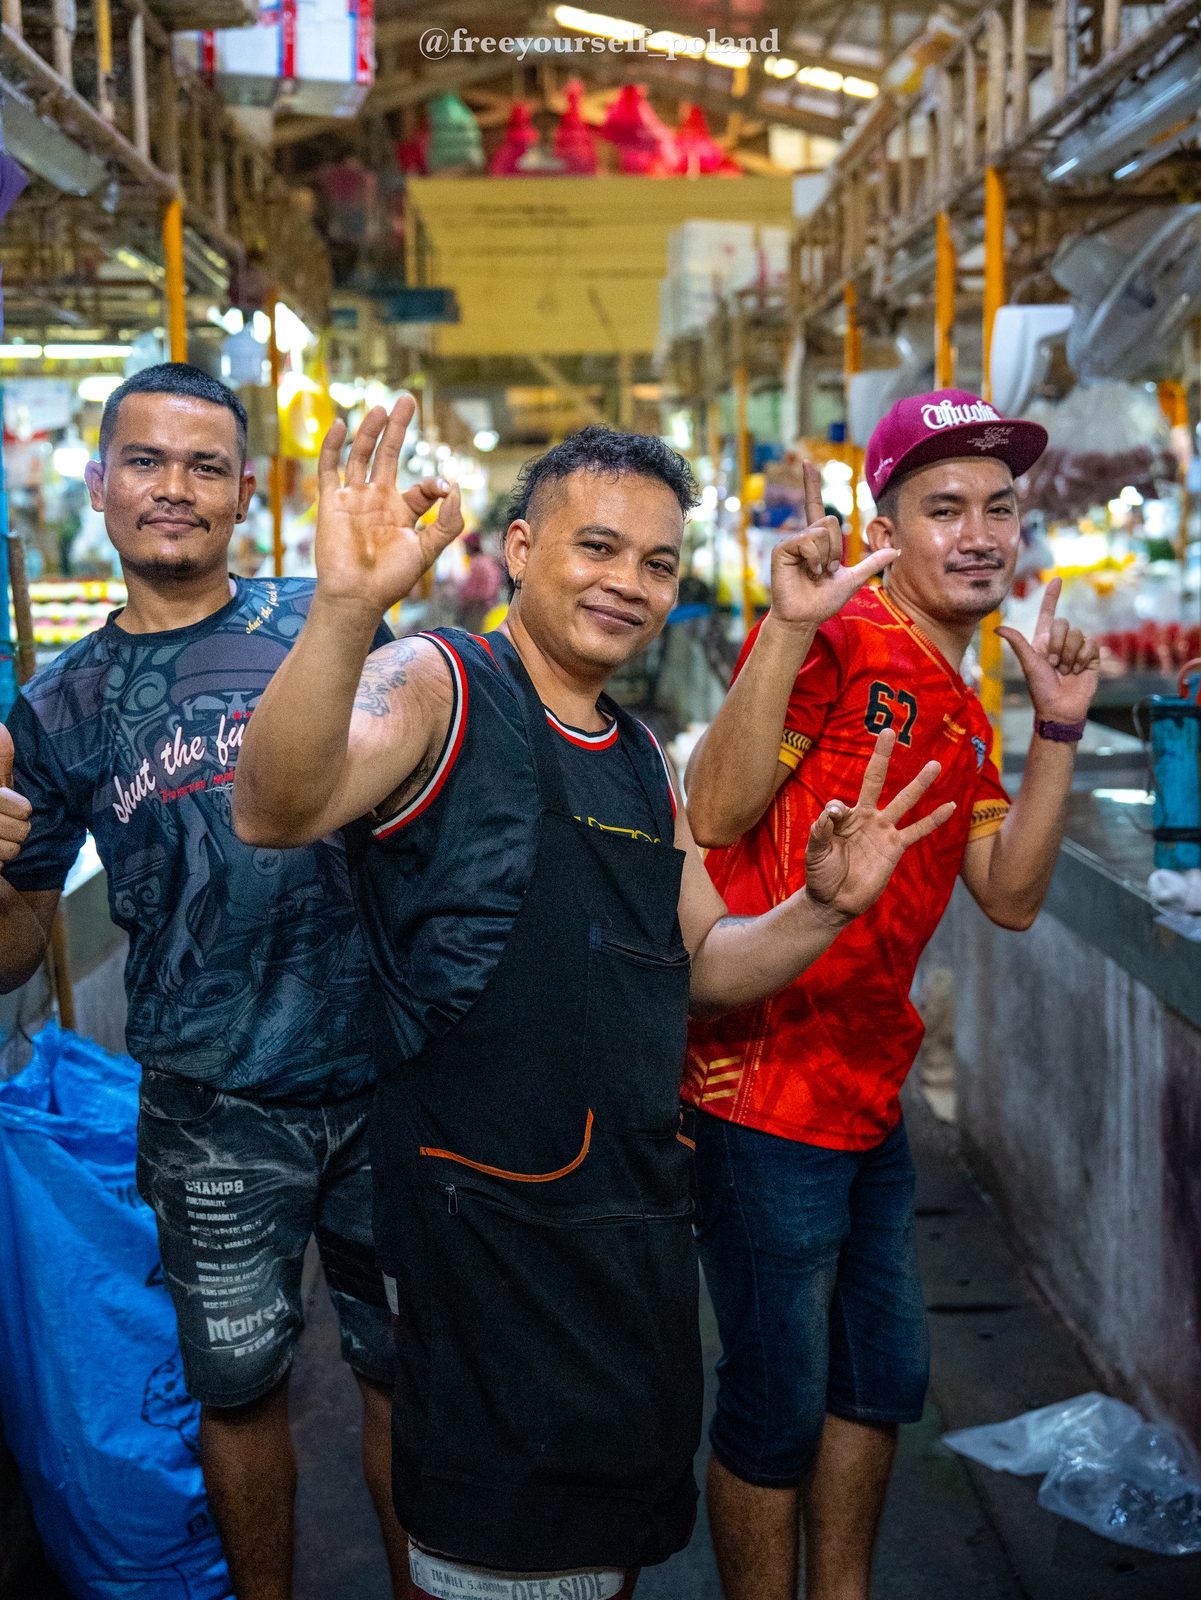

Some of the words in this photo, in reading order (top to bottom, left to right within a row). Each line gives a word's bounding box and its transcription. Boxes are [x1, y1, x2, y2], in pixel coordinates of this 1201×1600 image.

[864, 679, 918, 749] 67
[112, 758, 156, 824] shut
[160, 726, 205, 776] the
[216, 714, 245, 766] fu
